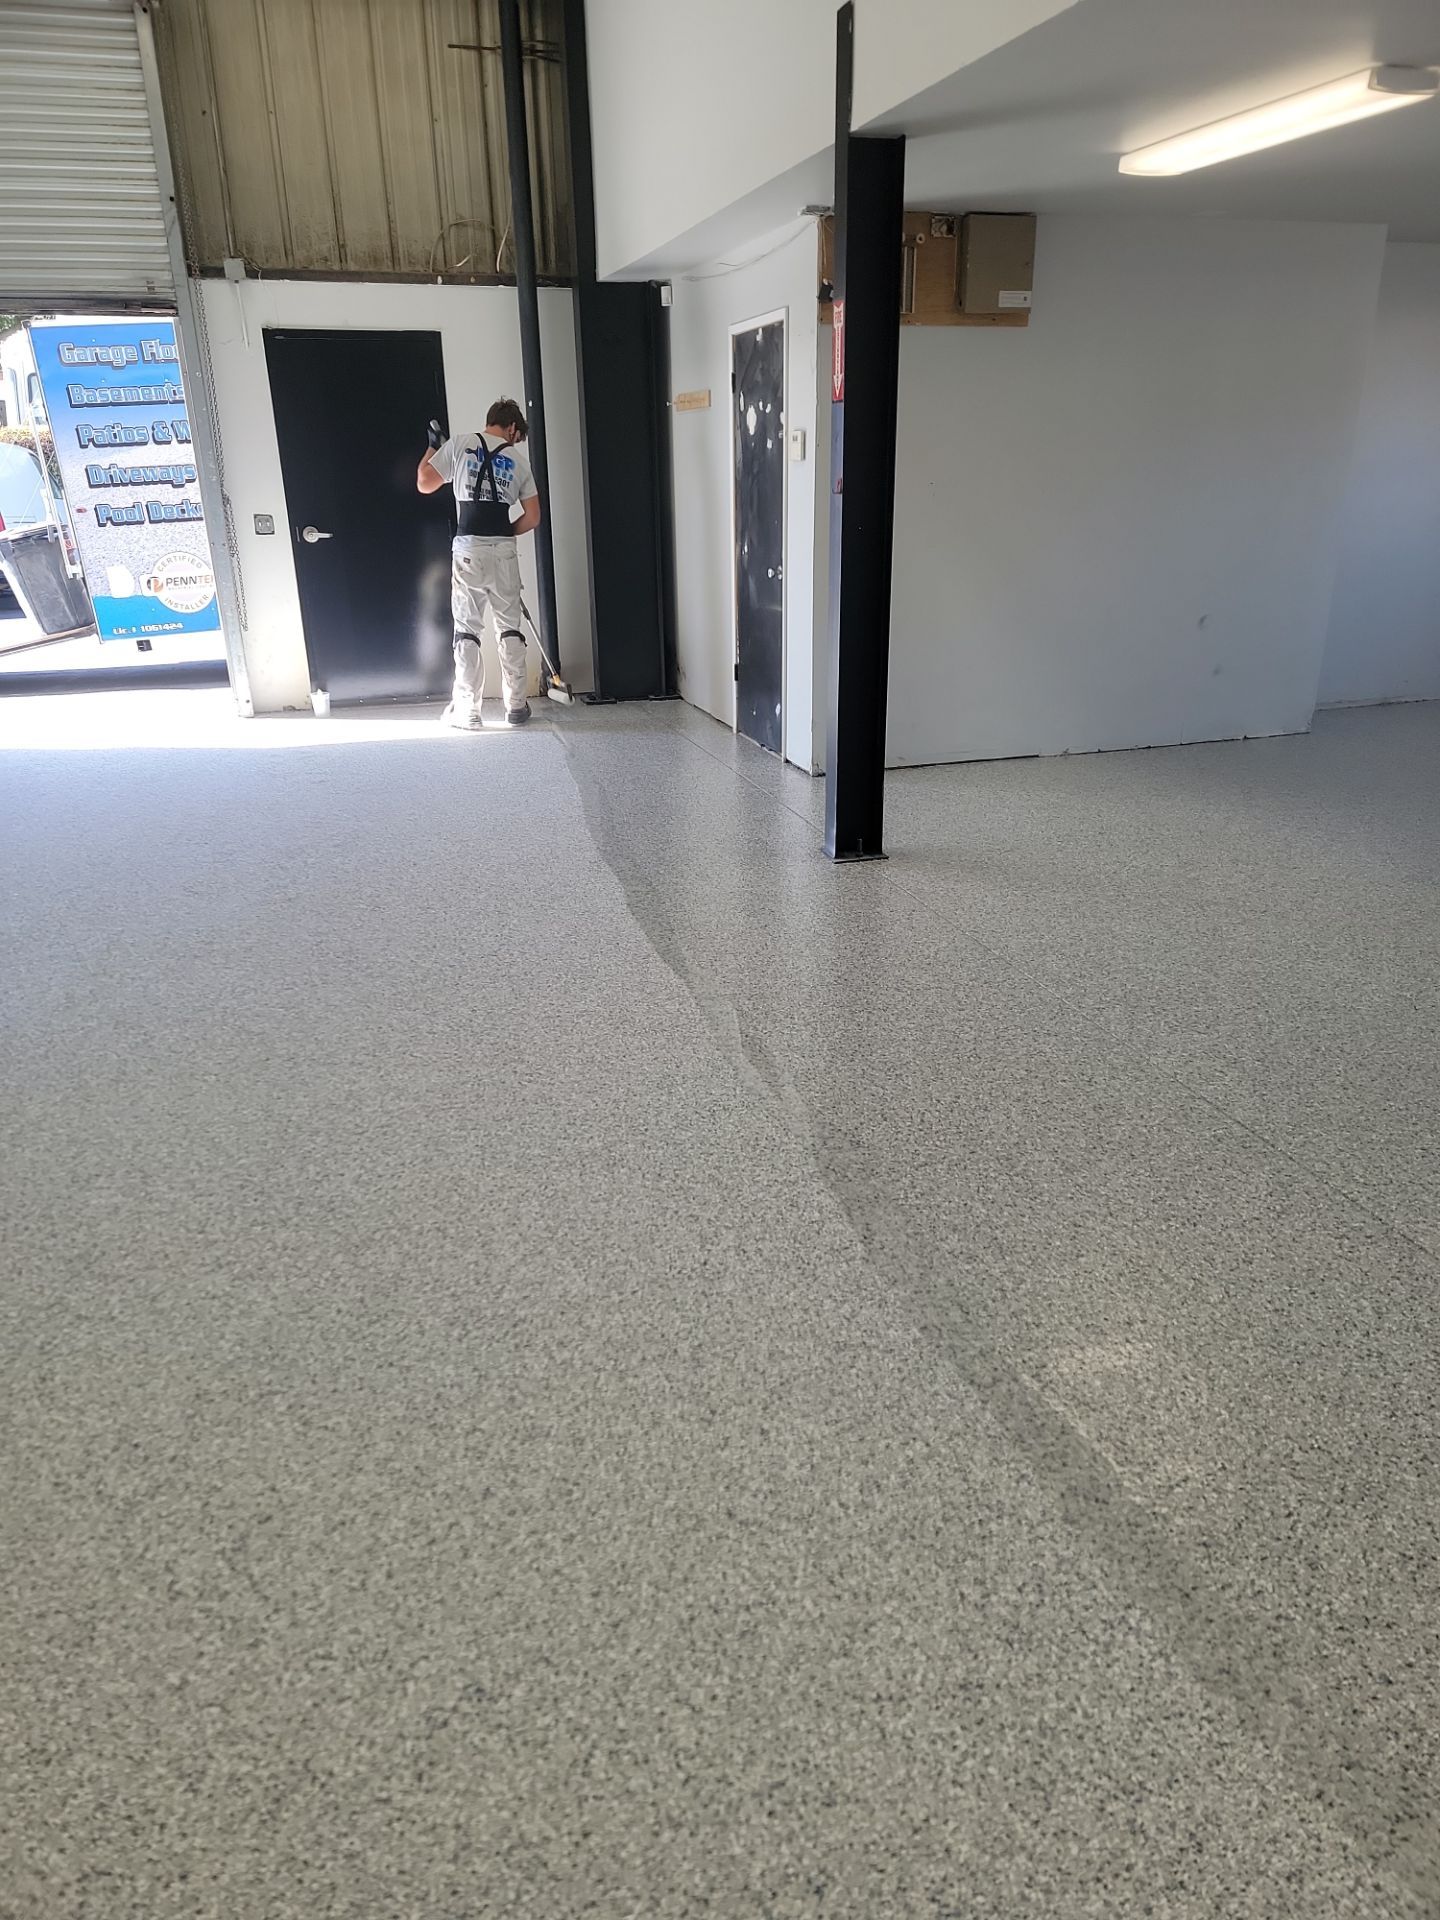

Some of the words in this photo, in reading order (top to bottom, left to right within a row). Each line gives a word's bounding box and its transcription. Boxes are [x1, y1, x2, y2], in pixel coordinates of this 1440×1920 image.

[59, 342, 138, 369] Garage
[76, 423, 149, 448] Patios
[152, 420, 172, 445] &
[86, 463, 196, 488] Driveways
[95, 502, 145, 527] Pool
[157, 555, 202, 572] CERTIFIED
[164, 594, 209, 610] INSTALLER
